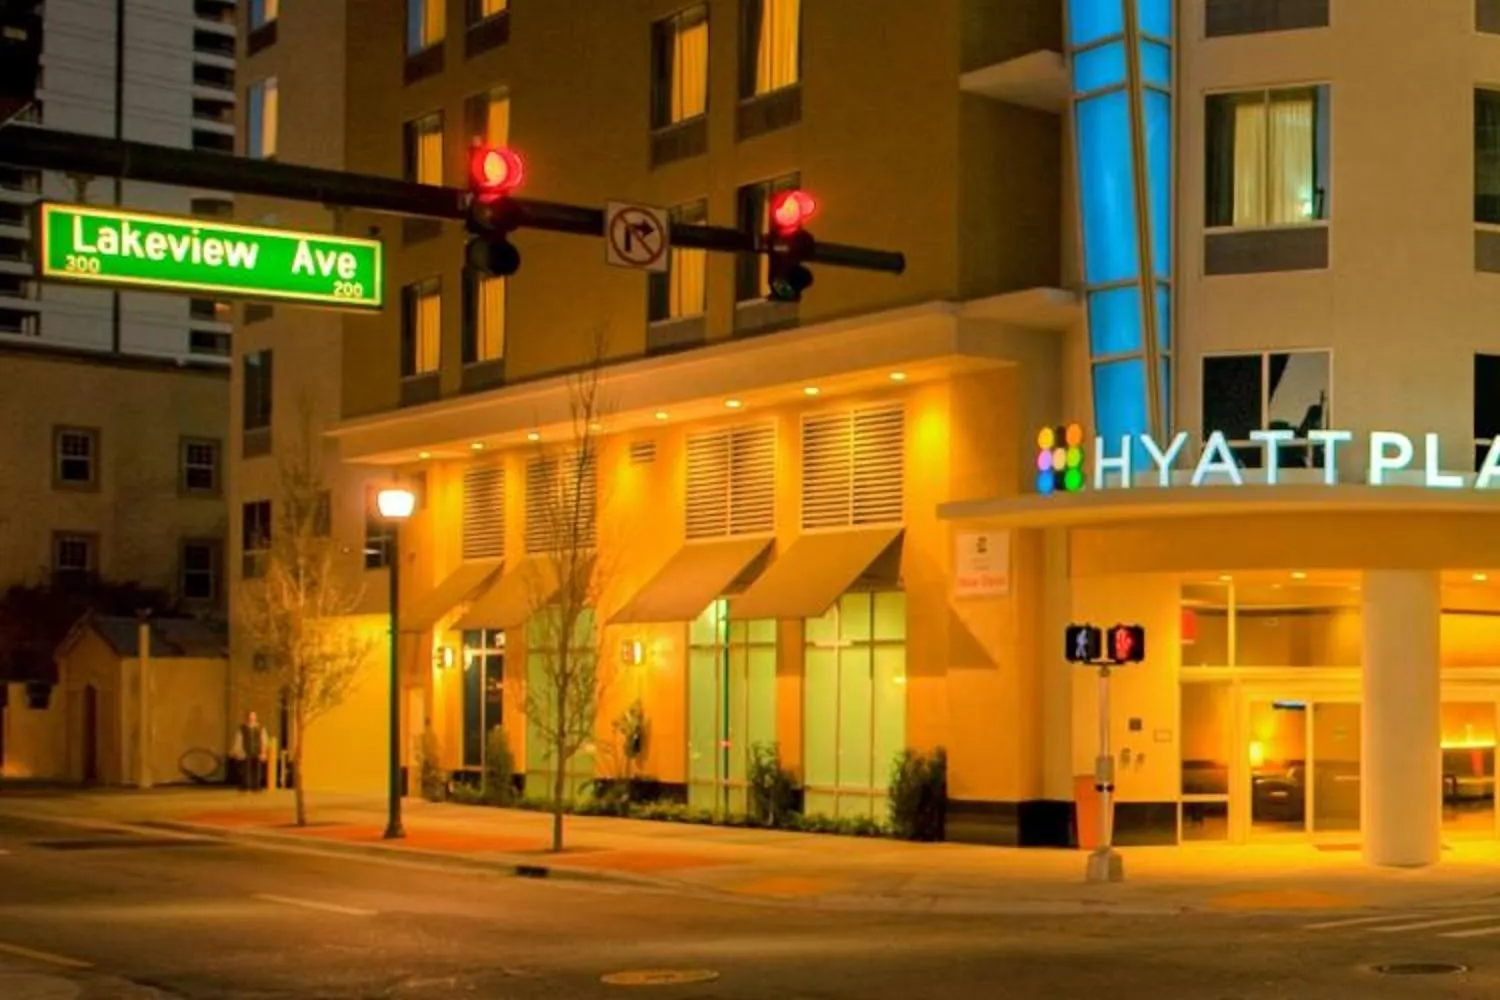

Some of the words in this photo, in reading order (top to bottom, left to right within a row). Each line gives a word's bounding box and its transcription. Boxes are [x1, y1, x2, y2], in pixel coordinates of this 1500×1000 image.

[65, 255, 99, 275] 300
[72, 215, 259, 270] Lakeview
[291, 240, 357, 279] Ave
[332, 281, 363, 299] 200
[1093, 430, 1351, 489] HYATT
